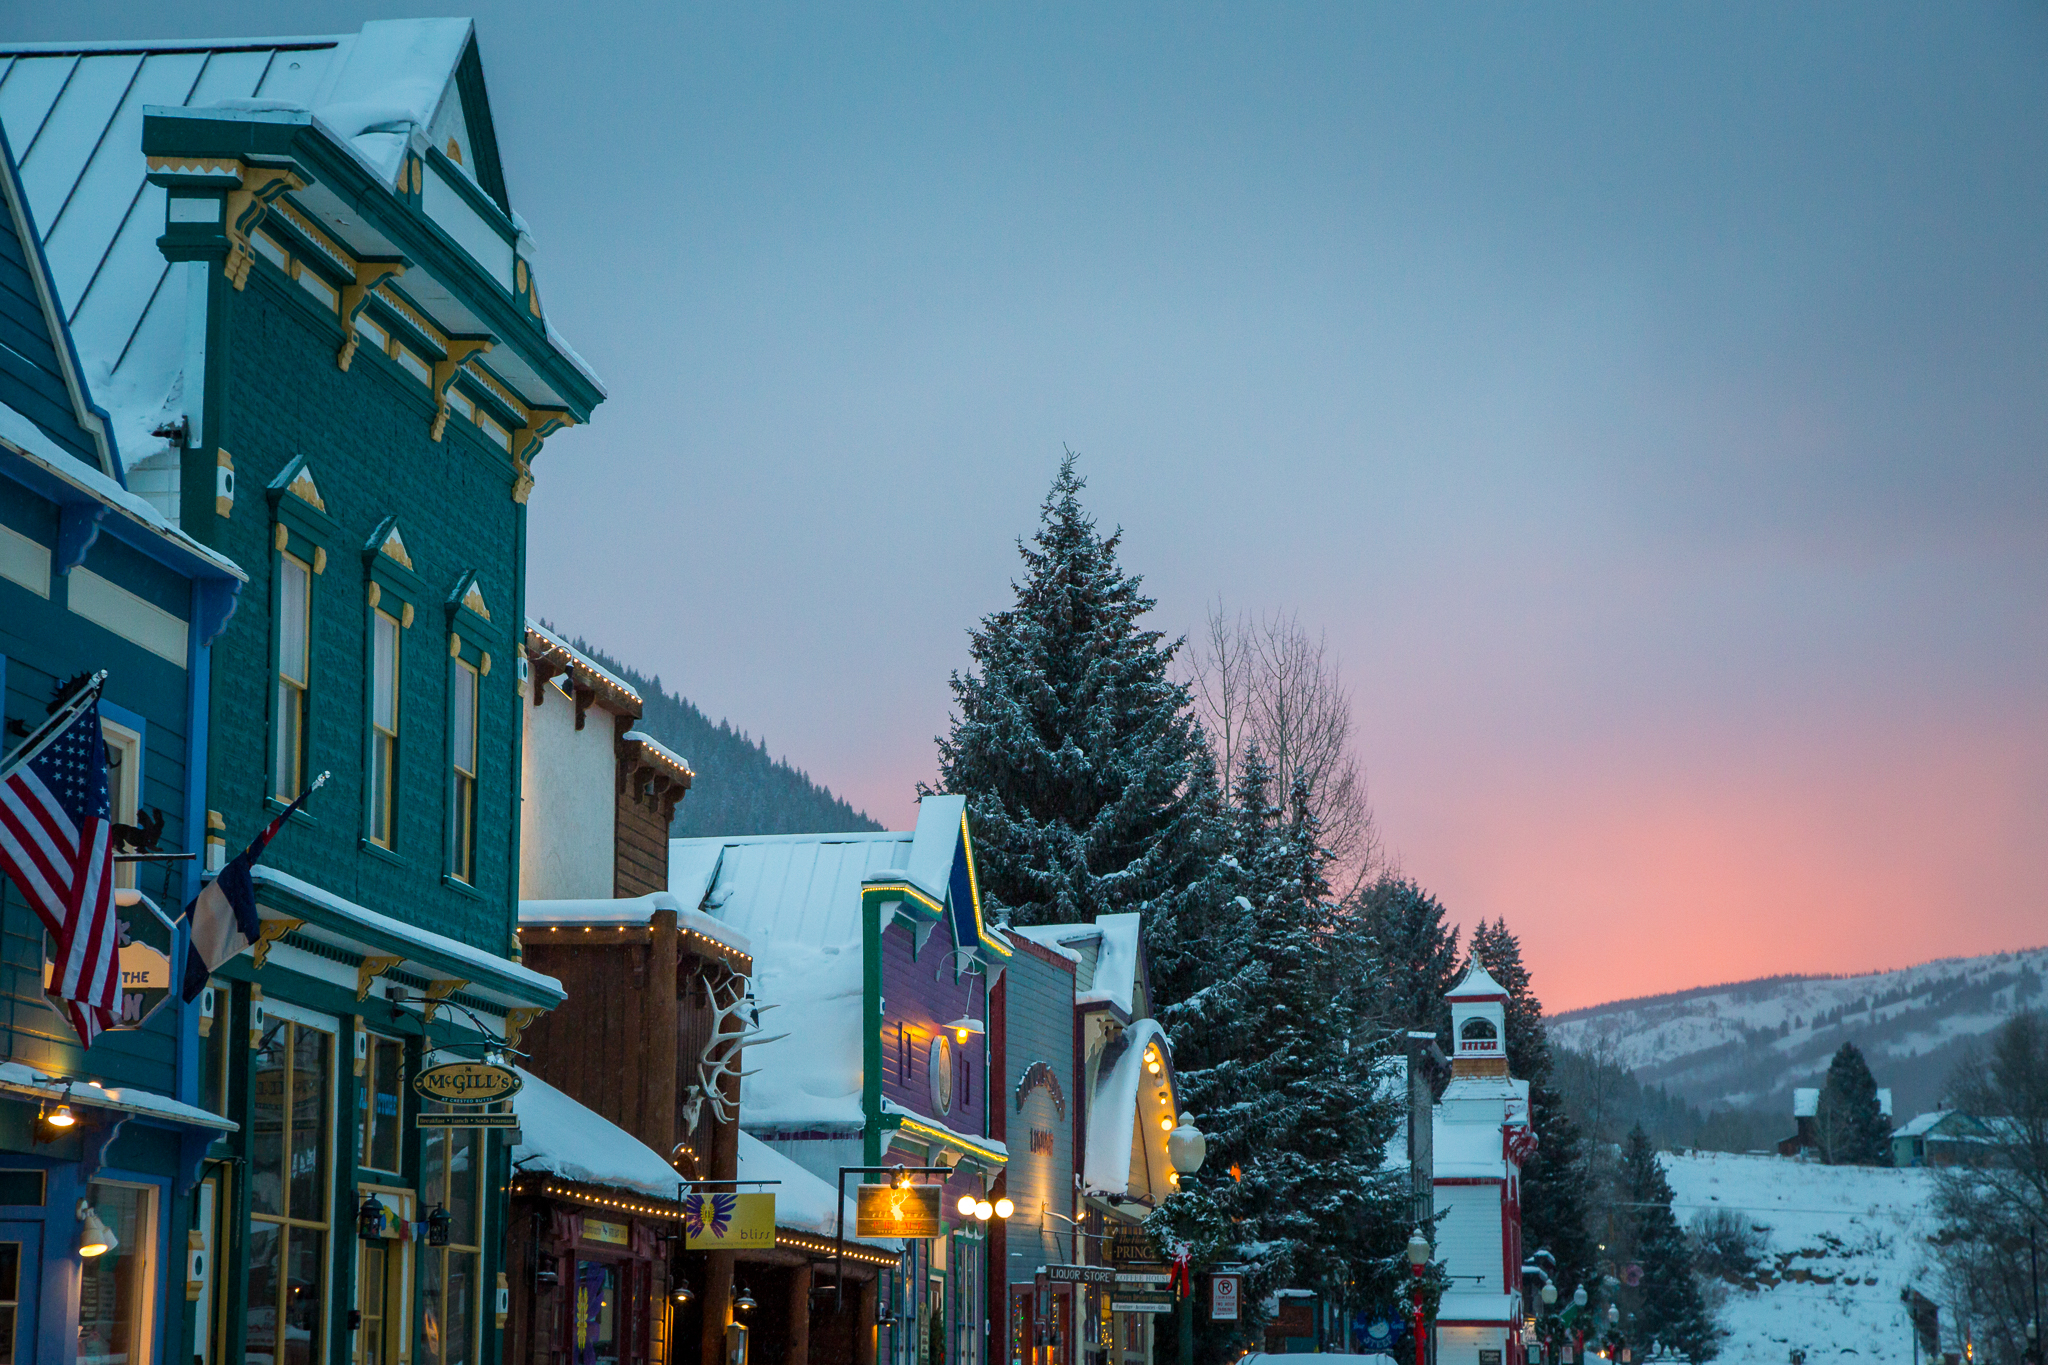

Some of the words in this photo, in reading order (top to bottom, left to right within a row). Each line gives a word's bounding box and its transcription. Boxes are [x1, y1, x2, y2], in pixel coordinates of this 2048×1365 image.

[122, 971, 150, 984] THE
[740, 1229, 771, 1240] bliss
[1050, 1268, 1081, 1281] LIQUOR
[1083, 1271, 1111, 1283] STORE
[1115, 1274, 1144, 1282] COFFEE
[1145, 1274, 1171, 1282] HOUSE
[1363, 1334, 1392, 1348] STEEP
